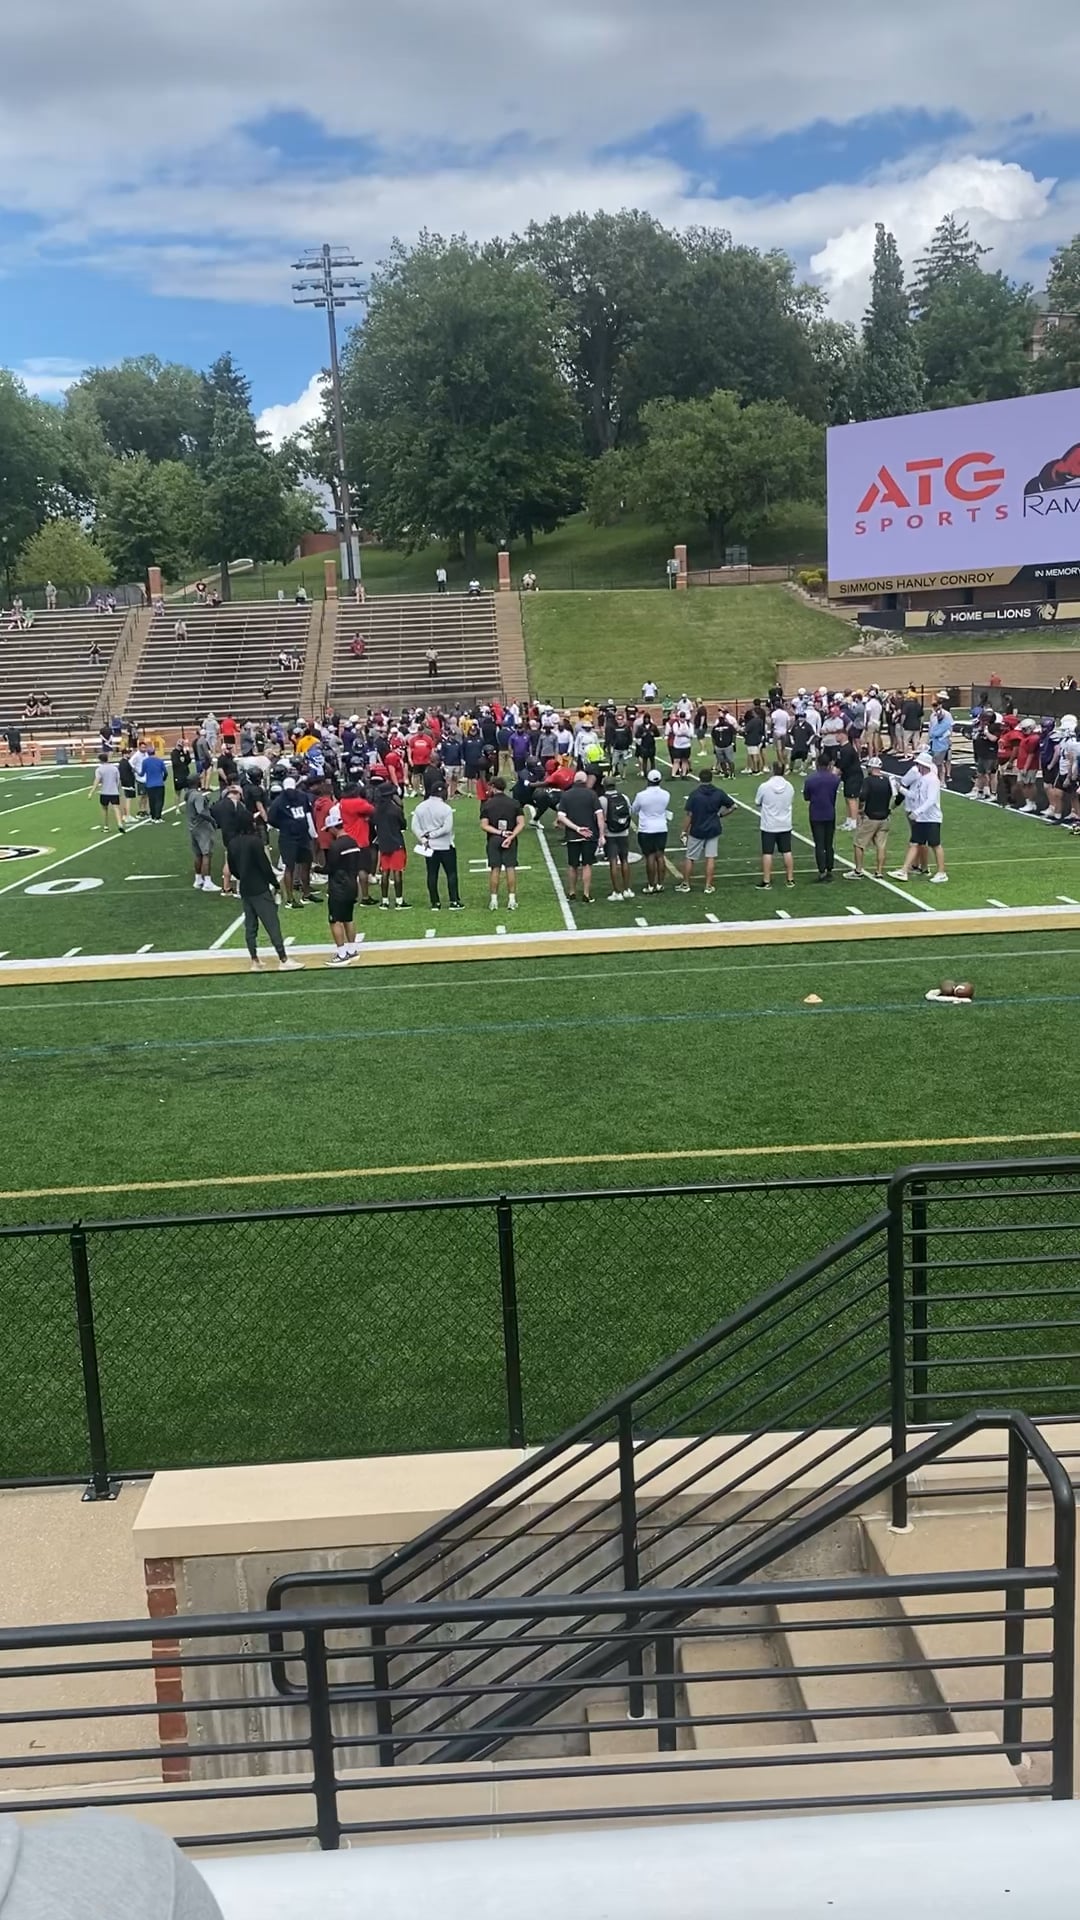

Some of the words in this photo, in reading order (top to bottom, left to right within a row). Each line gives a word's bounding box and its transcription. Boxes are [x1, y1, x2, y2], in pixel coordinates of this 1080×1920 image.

[856, 451, 1005, 513] ATG
[855, 504, 1008, 535] SPORTS
[840, 580, 893, 594] SIMMONS
[896, 577, 937, 589] HANLY
[940, 573, 995, 585] CONROY
[950, 610, 982, 622] HOME
[996, 608, 1031, 619] LIONS
